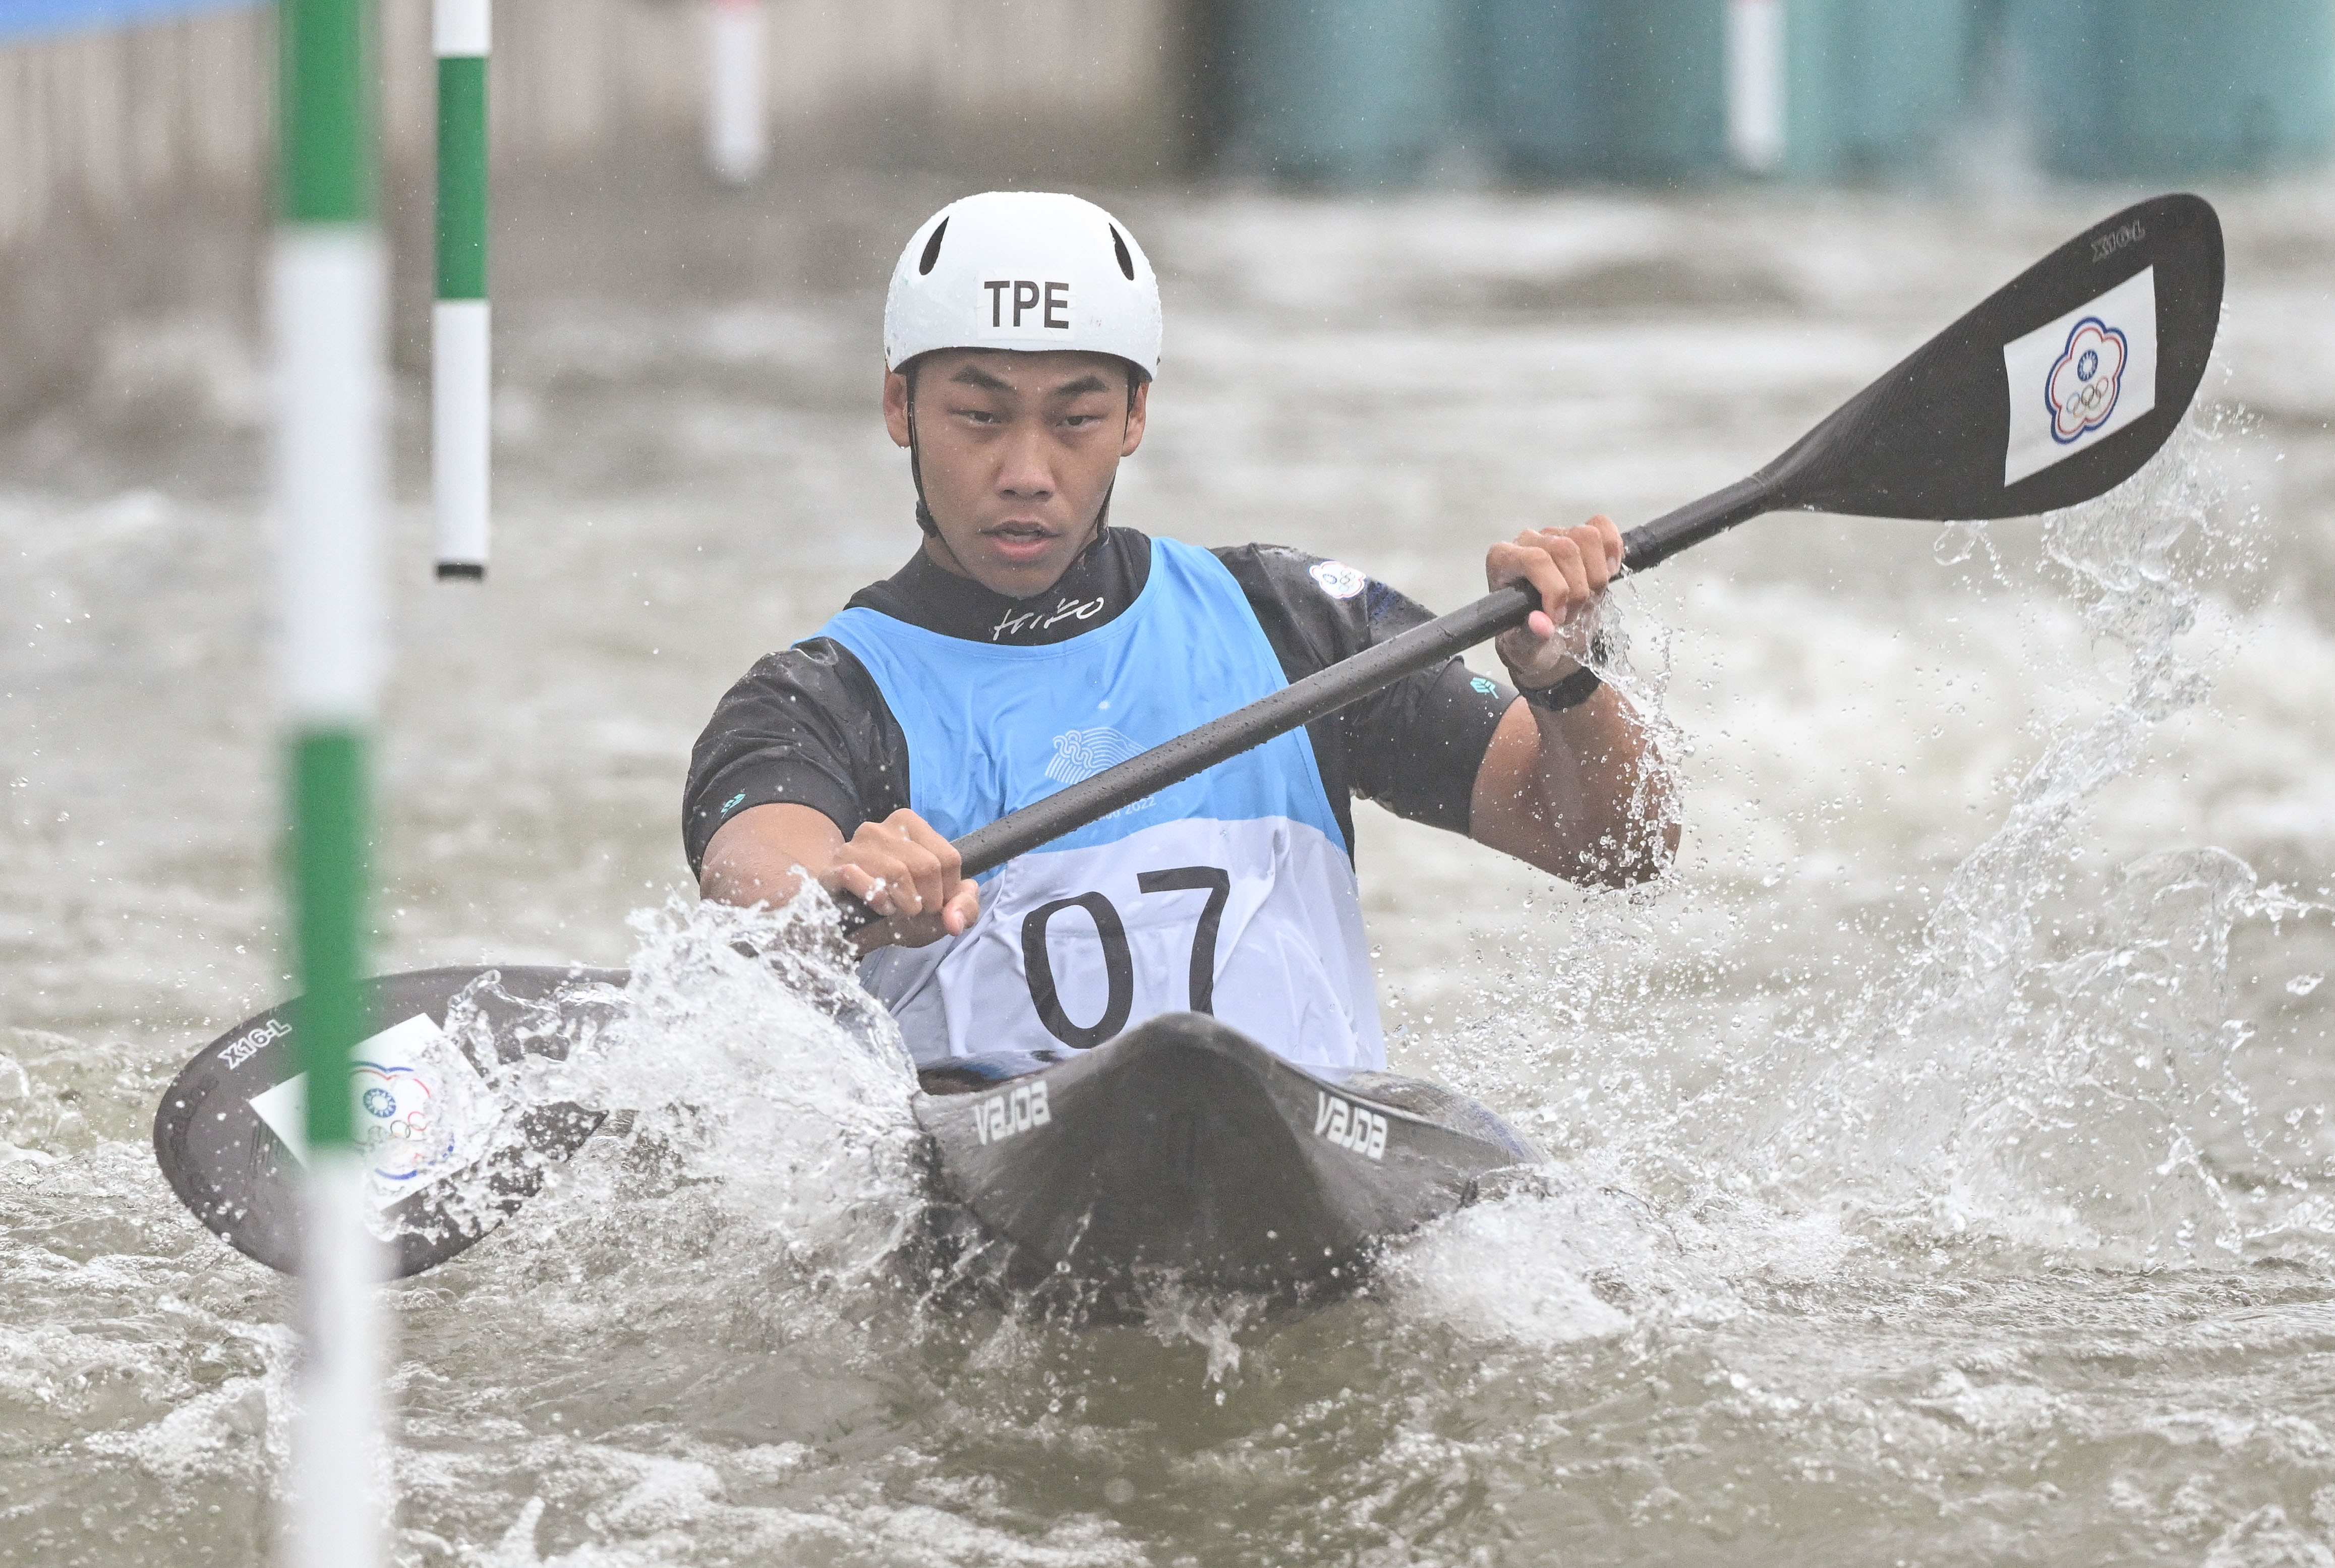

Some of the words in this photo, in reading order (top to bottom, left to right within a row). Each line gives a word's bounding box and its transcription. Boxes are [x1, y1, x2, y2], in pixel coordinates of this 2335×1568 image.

[984, 280, 1069, 329] TPE
[1125, 796, 1157, 815] 2022
[1021, 866, 1231, 1049] 07
[217, 1018, 293, 1070] X16-L
